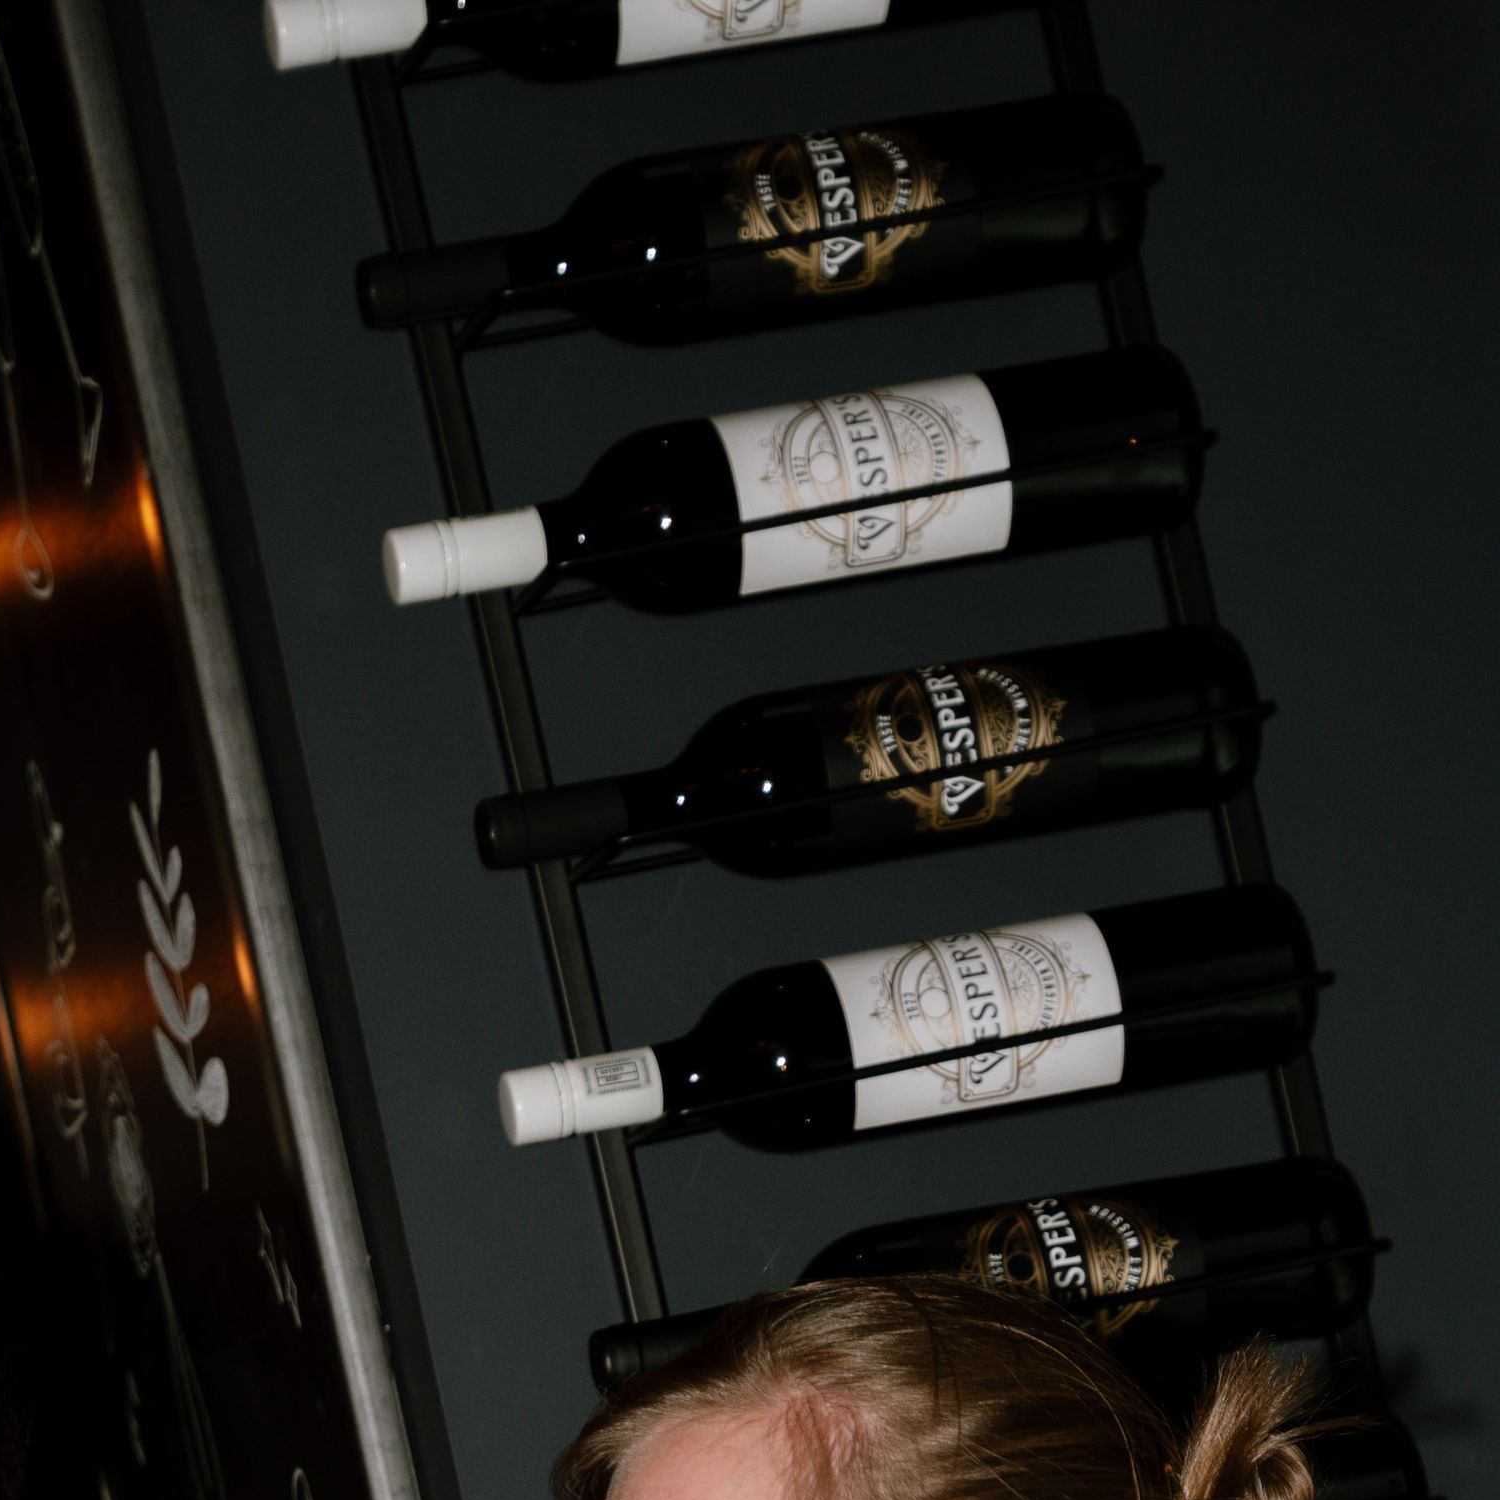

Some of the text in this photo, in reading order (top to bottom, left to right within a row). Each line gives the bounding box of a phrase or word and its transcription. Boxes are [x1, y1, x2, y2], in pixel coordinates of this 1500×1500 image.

[755, 174, 777, 210] TASTE
[802, 131, 865, 277] VESPER
[834, 394, 897, 550] VSPER'S
[876, 714, 898, 754] TASTE
[1040, 968, 1058, 1029] AUVIGNON
[1088, 1204, 1140, 1249] MISSION
[987, 1252, 1006, 1285] ASTE
